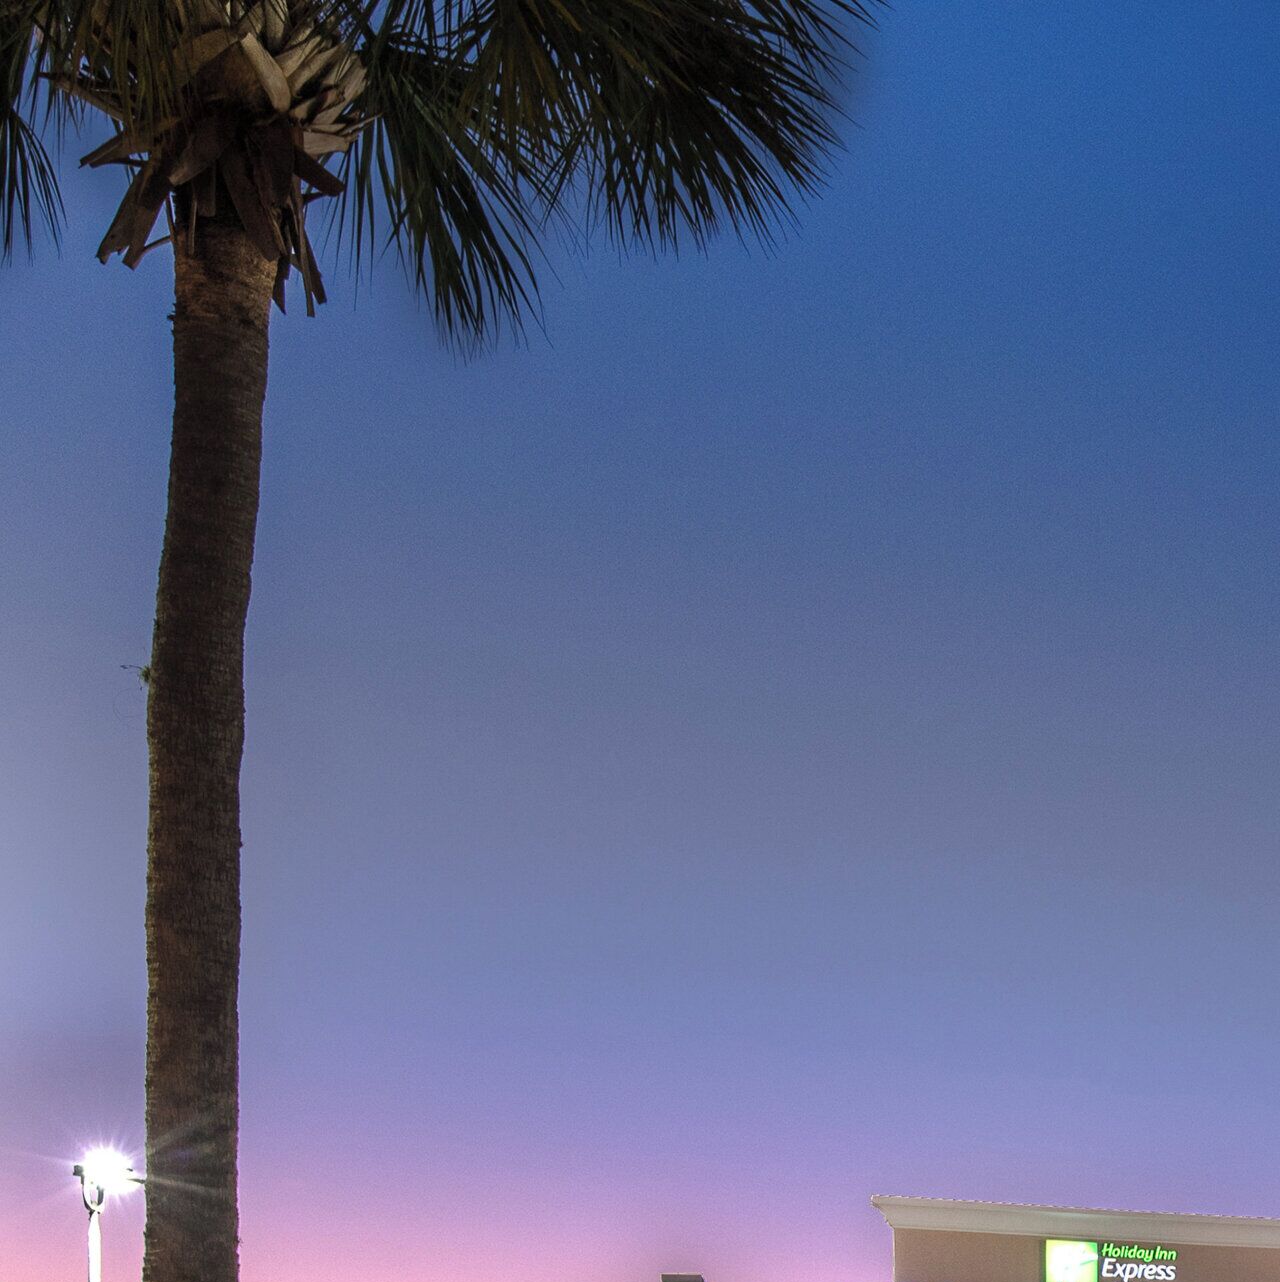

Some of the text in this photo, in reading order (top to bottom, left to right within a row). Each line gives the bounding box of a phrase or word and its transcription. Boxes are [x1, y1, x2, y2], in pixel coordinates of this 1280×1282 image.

[1101, 1243, 1177, 1262] Holiday Inn
[1101, 1257, 1176, 1282] Express
